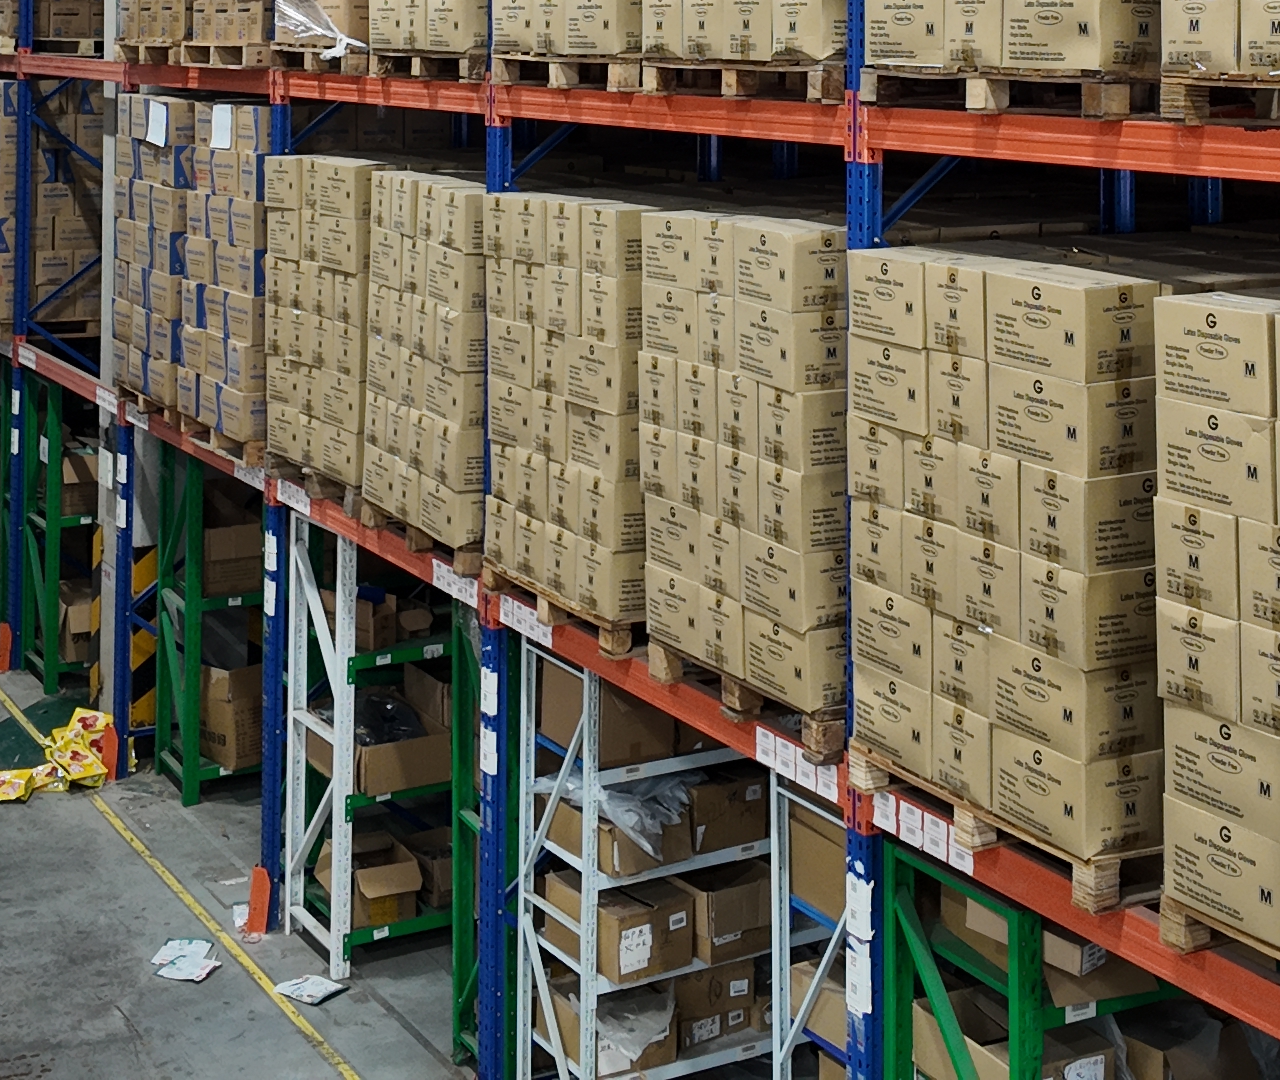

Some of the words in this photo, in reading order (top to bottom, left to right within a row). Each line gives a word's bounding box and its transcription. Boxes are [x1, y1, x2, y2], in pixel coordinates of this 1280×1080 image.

[779, 268, 785, 281] M
[1032, 286, 1041, 300] G
[1064, 333, 1074, 344] M
